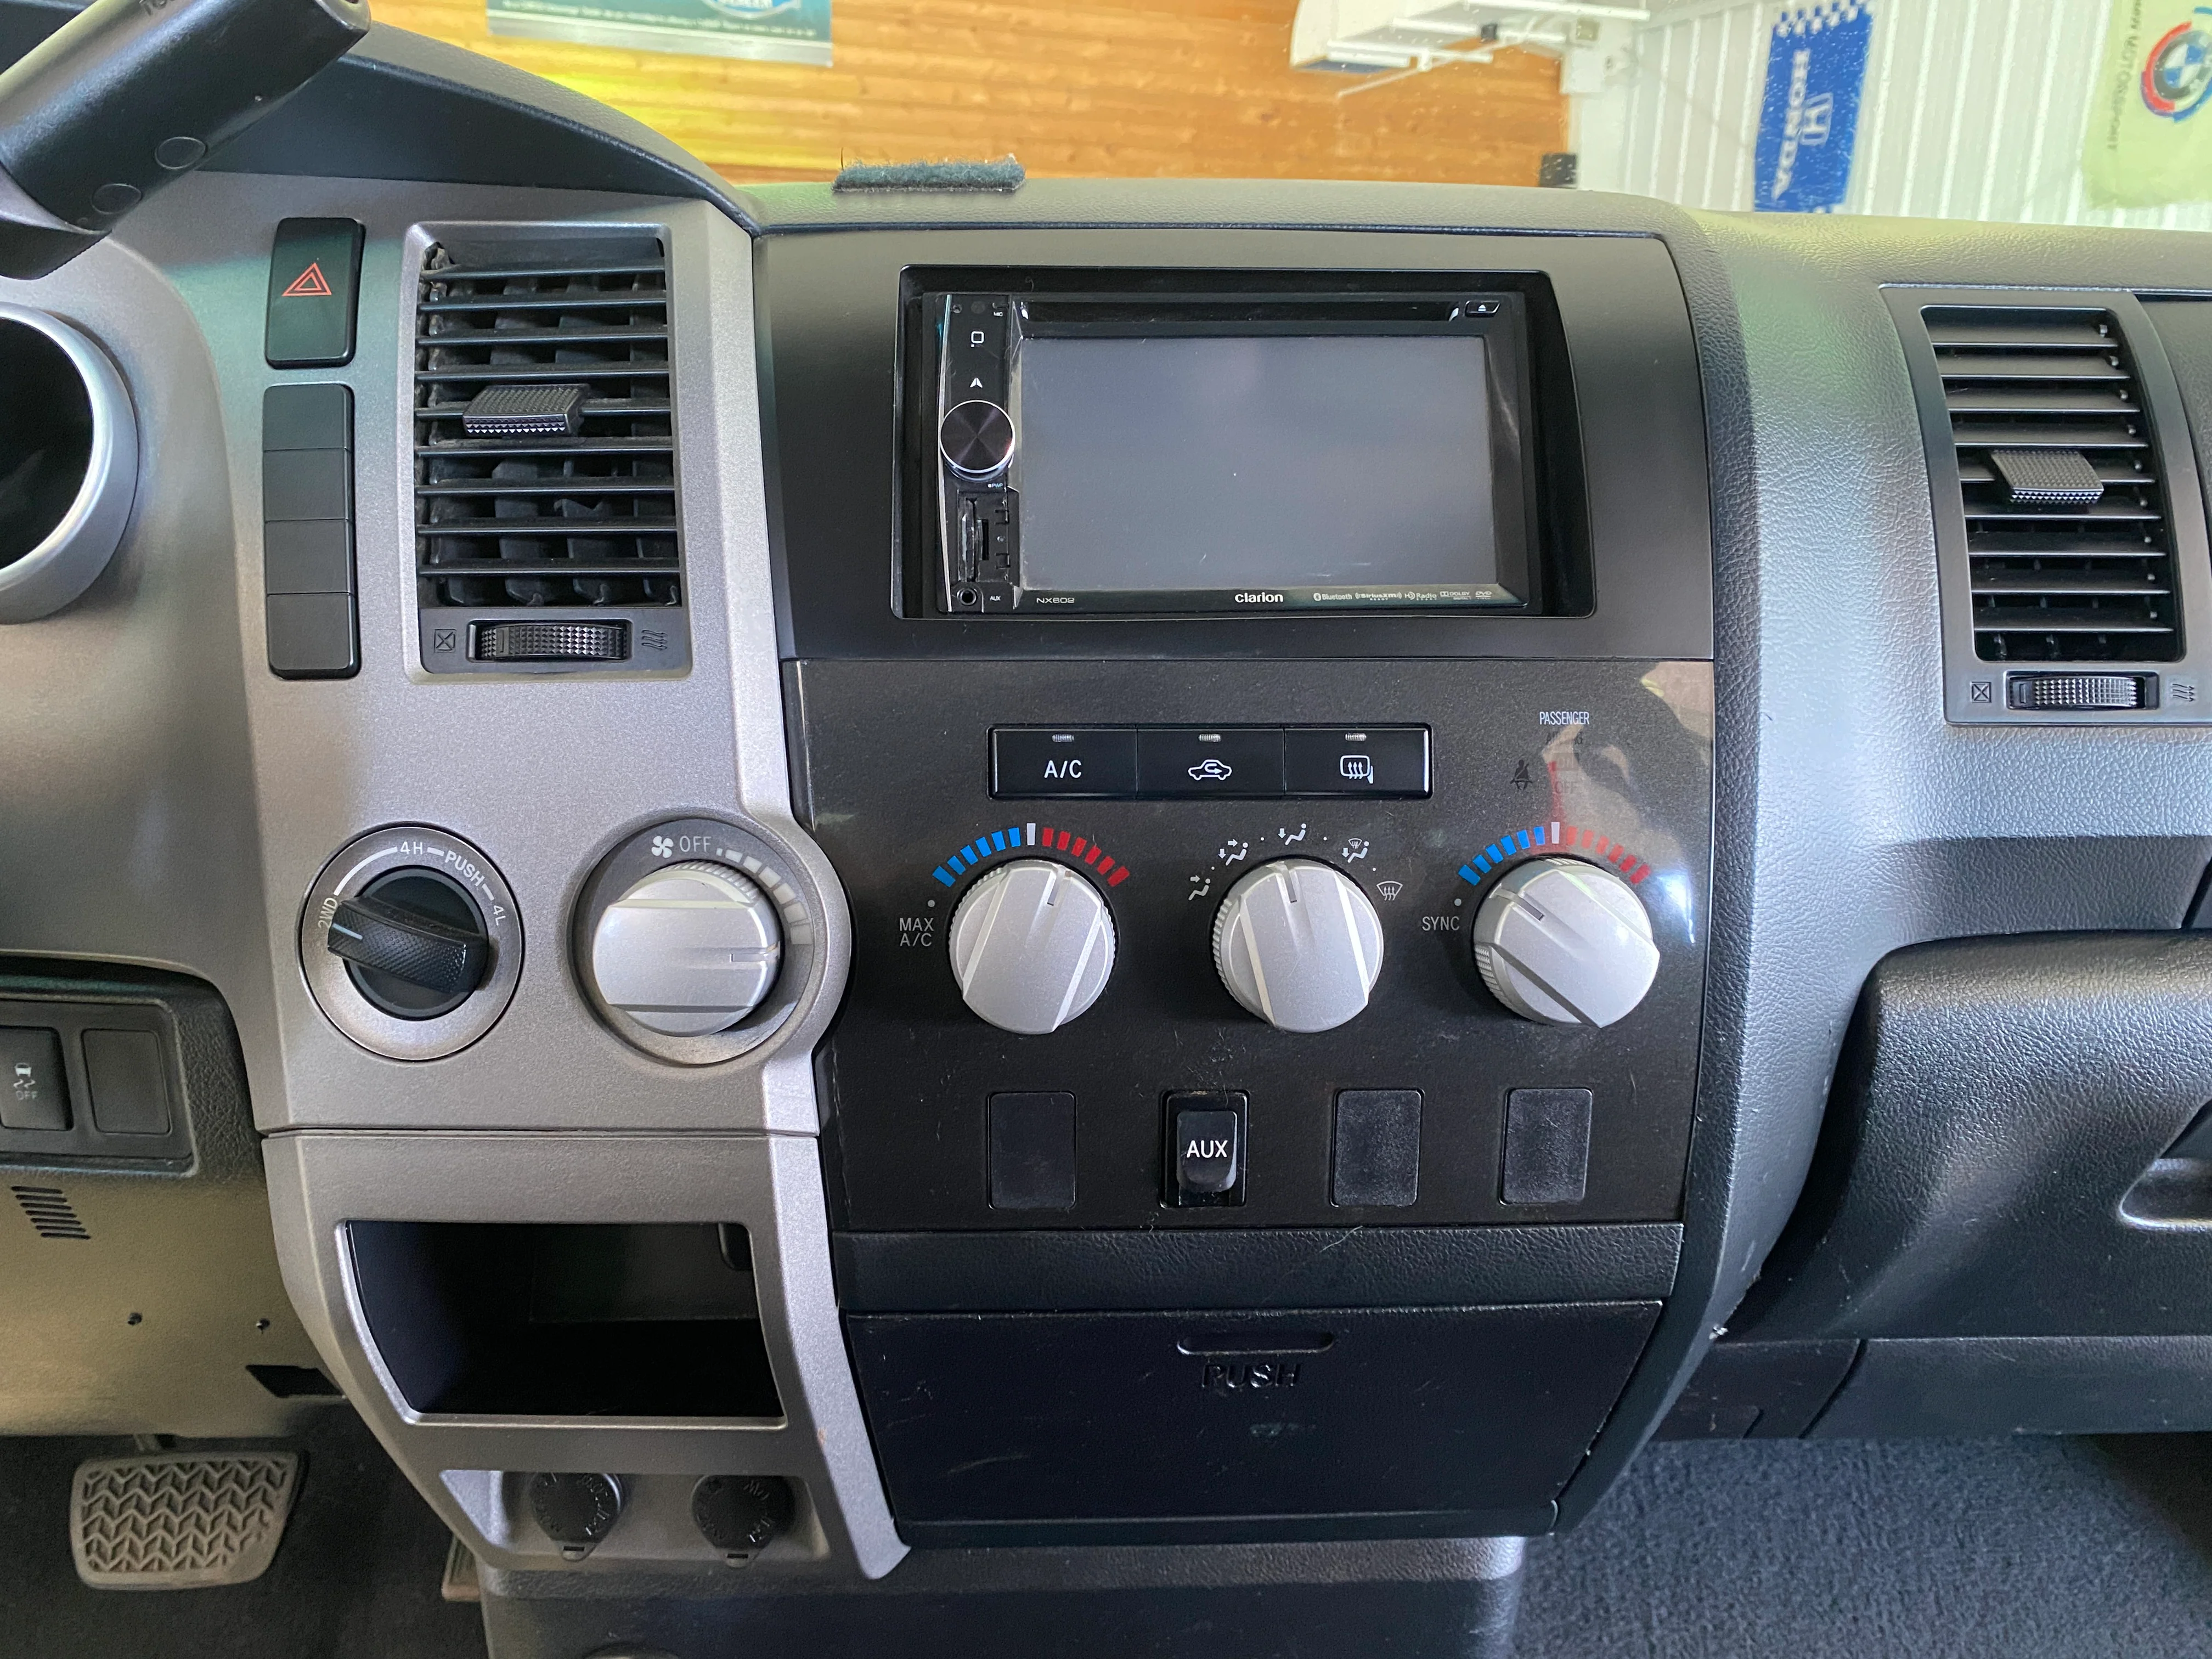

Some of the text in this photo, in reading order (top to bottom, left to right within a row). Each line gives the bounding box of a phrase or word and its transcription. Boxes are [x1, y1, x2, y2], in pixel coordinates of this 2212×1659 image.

[1771, 48, 1810, 202] HONDA
[1234, 592, 1284, 603] clarion
[1539, 711, 1590, 725] PASSENGER
[1044, 759, 1082, 778] A/C
[400, 841, 423, 855] 4H
[679, 835, 712, 853] OFF
[445, 850, 485, 887] PUSH
[318, 896, 339, 929] 2WD
[493, 905, 506, 926] 4L
[899, 917, 934, 932] MAX
[1421, 916, 1460, 931] SYNC
[900, 933, 932, 947] A/C
[15, 1091, 38, 1101] OFF
[1186, 1139, 1228, 1159] AUX
[1201, 1363, 1303, 1389] PUSH
